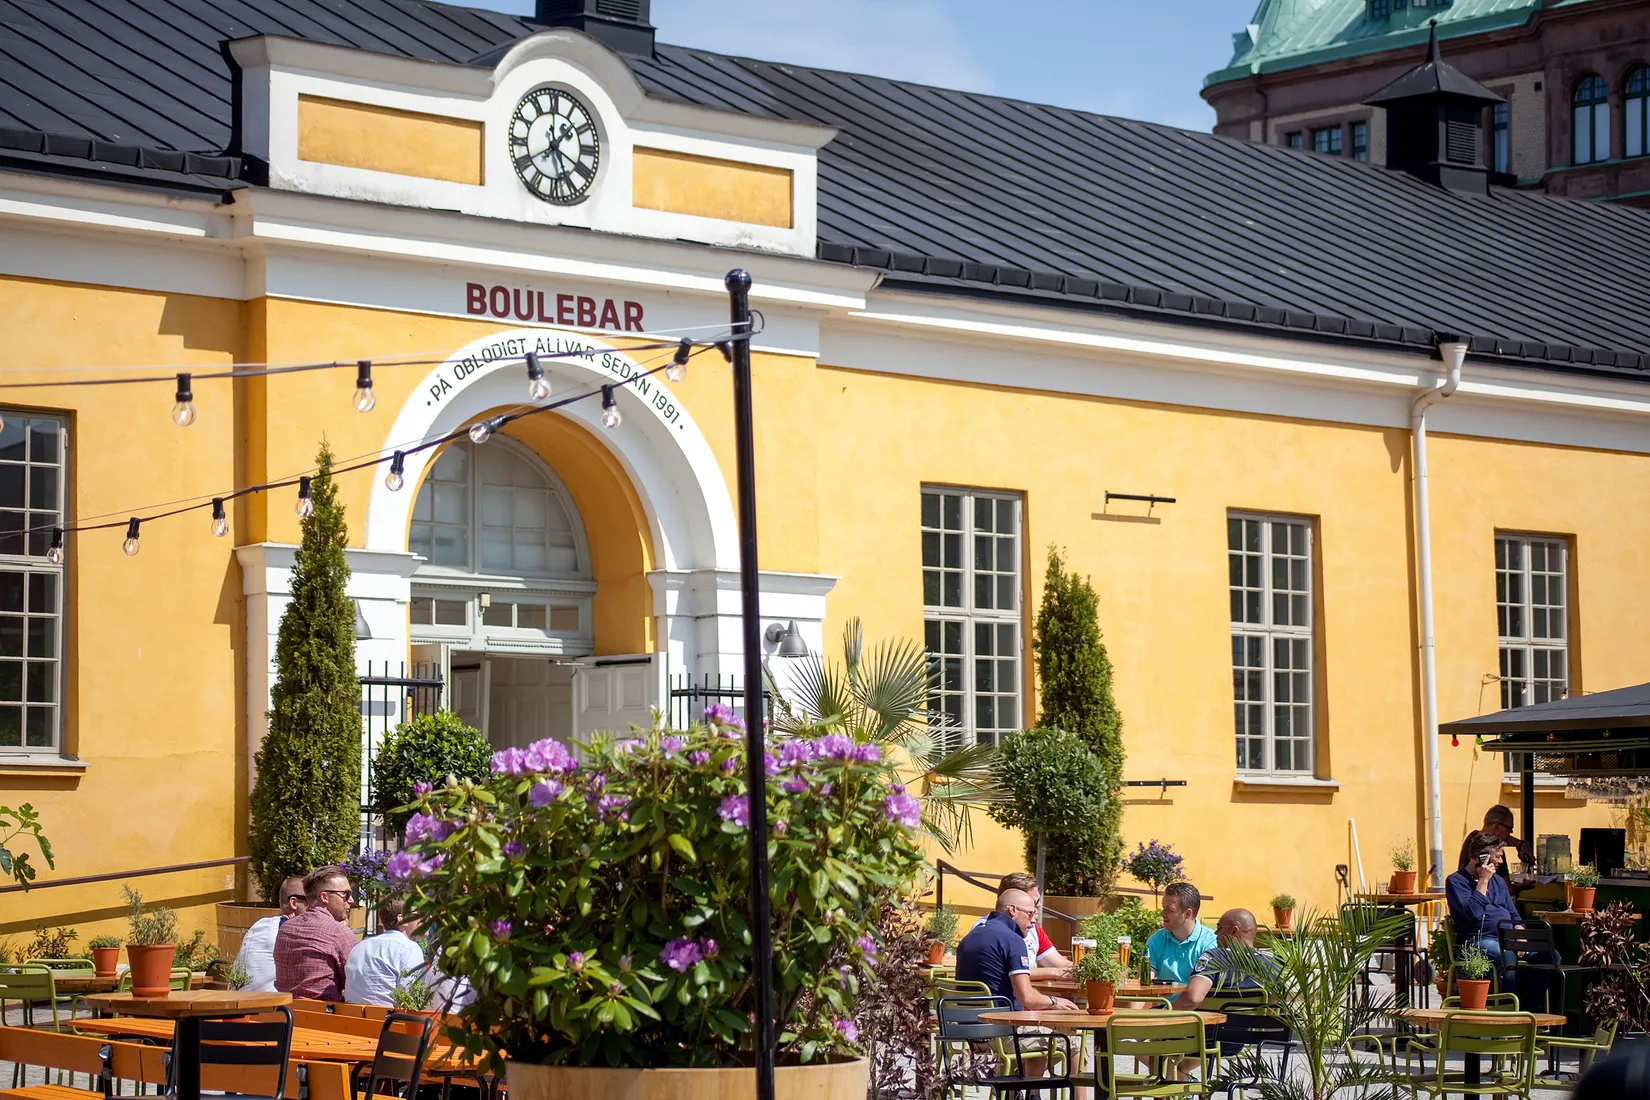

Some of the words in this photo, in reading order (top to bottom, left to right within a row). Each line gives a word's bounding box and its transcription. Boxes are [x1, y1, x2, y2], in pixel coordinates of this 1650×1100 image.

[466, 282, 644, 332] BOULEBAR
[429, 373, 453, 401] PÅ
[453, 338, 526, 381] OBLODIGT
[536, 337, 595, 363] ALLVAR
[601, 352, 651, 396] SEDAN
[651, 390, 680, 425] 1991
